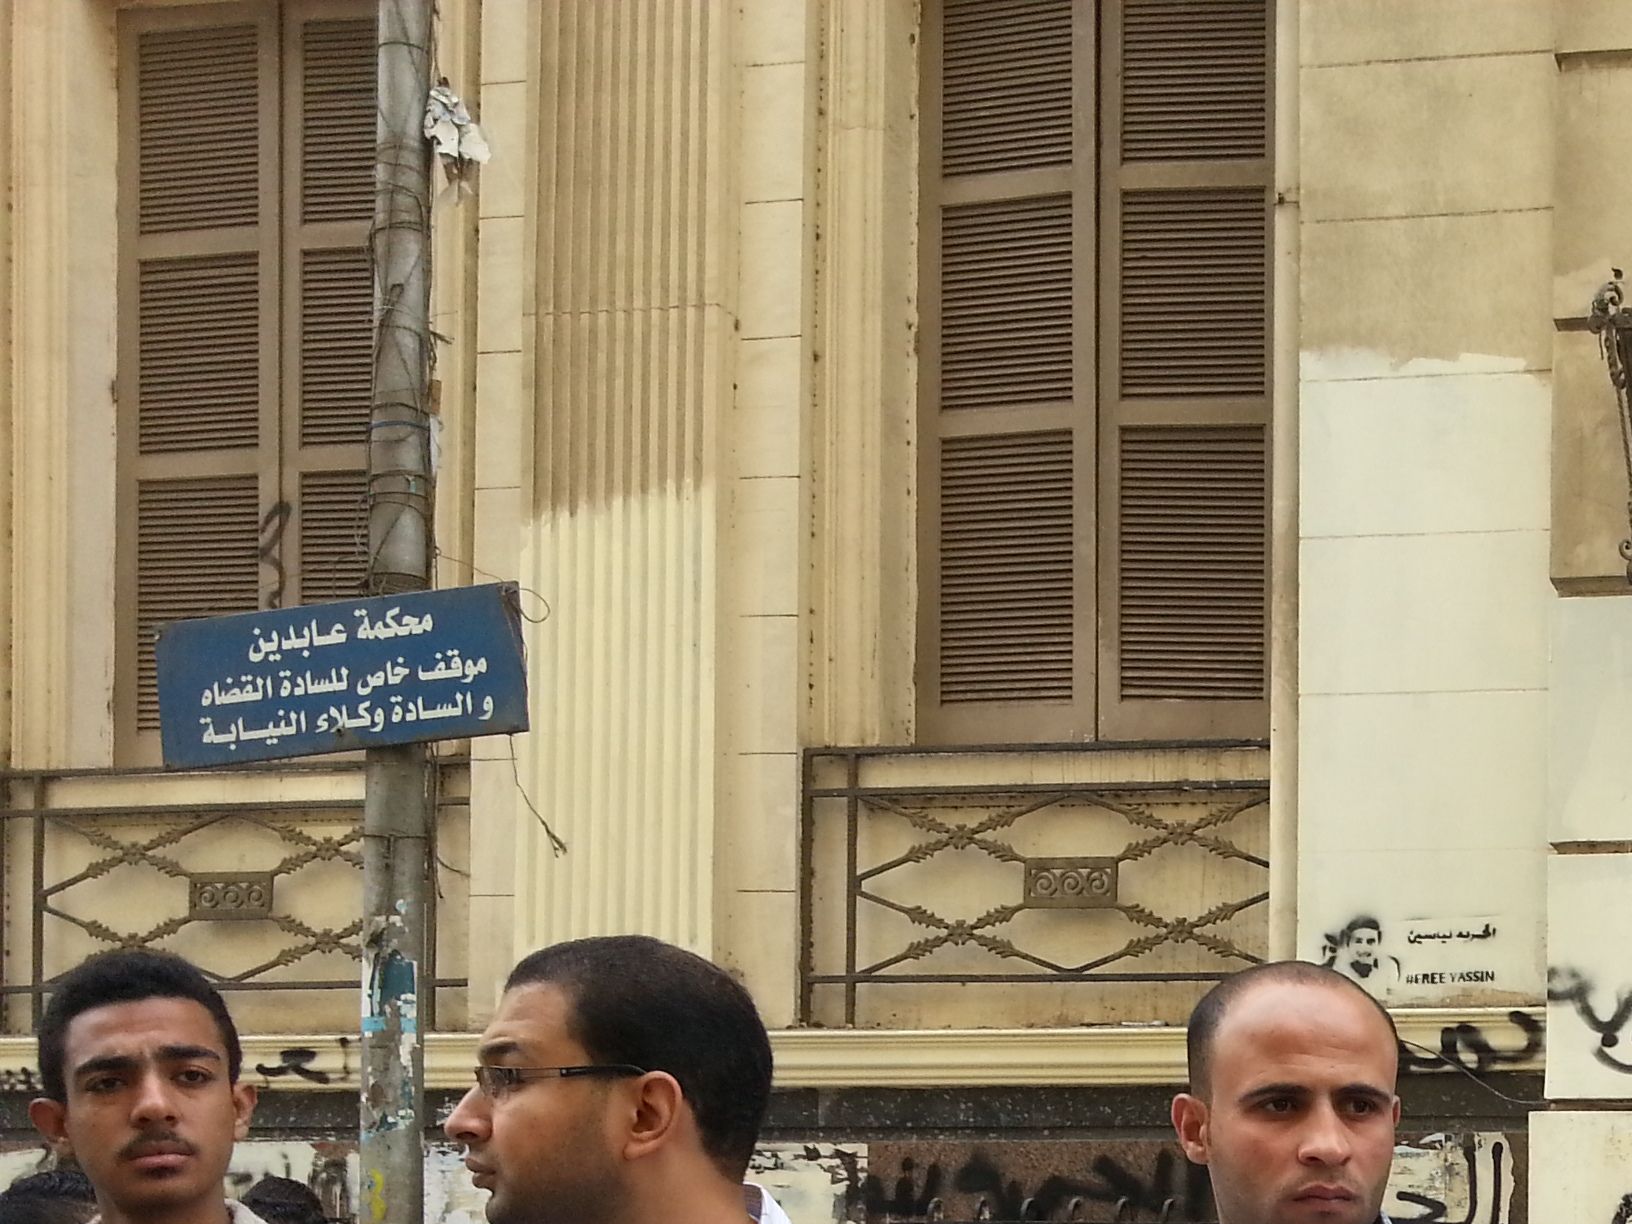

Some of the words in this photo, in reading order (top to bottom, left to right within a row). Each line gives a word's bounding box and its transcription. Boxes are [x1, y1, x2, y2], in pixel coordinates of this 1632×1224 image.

[248, 617, 348, 662] عابدين
[354, 606, 433, 641] محكمة
[279, 666, 349, 698] للسادة
[356, 656, 410, 696] خاص
[417, 648, 488, 684] موقف
[314, 700, 385, 734] وكلاء
[390, 690, 472, 723] السادة
[199, 708, 306, 751] النيابة
[1405, 972, 1446, 985] #FREE
[1450, 970, 1495, 983] YASSIN
